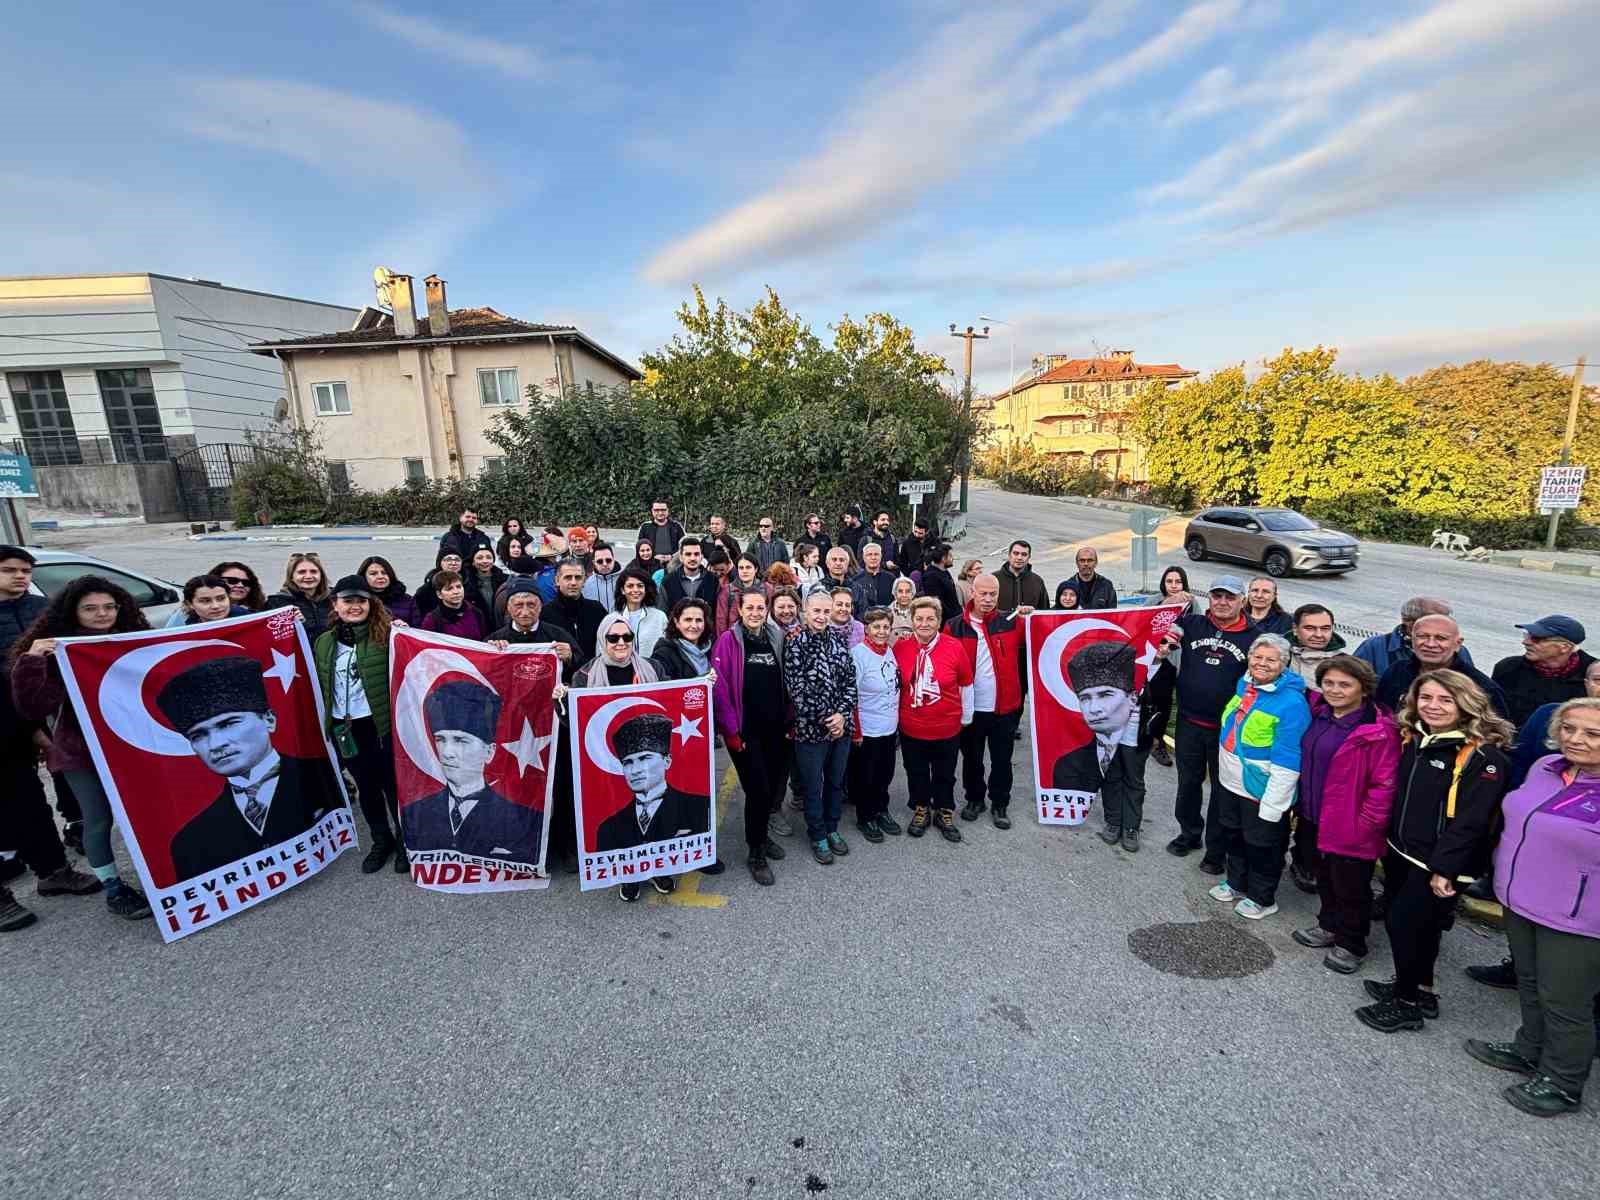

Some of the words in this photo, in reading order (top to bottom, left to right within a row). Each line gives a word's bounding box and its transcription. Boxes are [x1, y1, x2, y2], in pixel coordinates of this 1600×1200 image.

[1544, 477, 1581, 486] TARIM
[585, 836, 712, 866] DEVRİMLERİNİN
[585, 844, 712, 881] İZİNDEYİZ!
